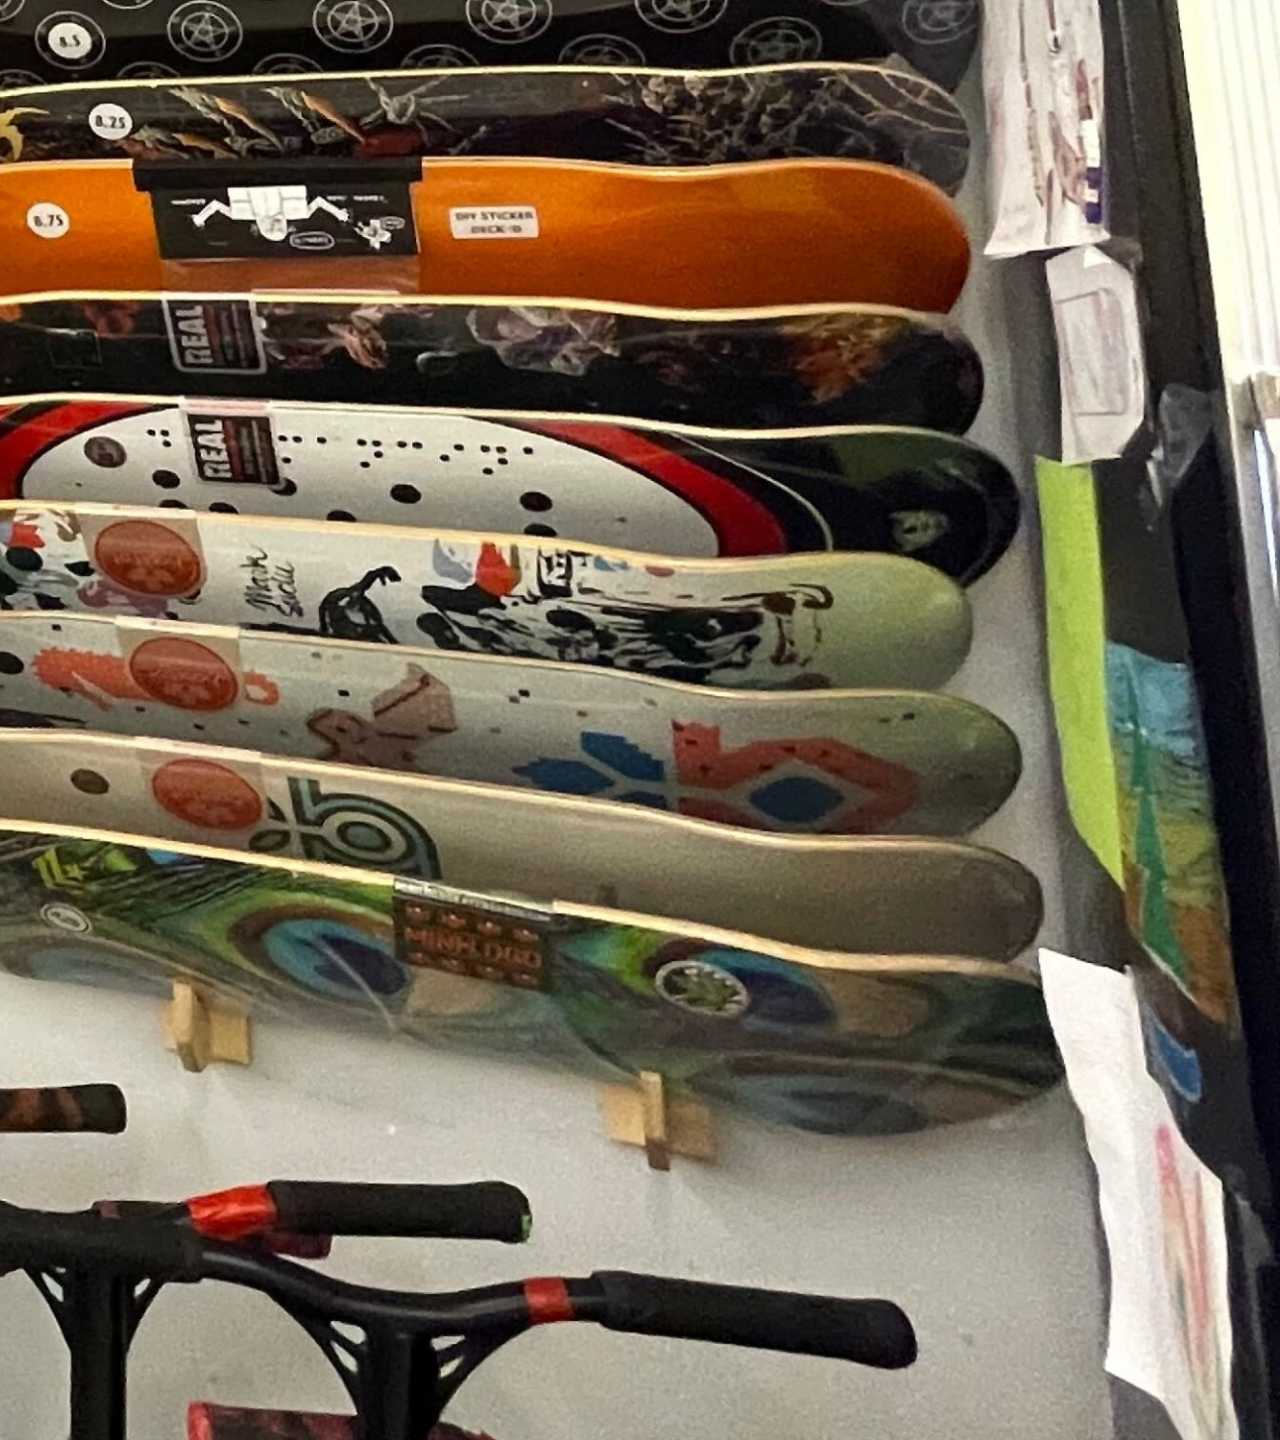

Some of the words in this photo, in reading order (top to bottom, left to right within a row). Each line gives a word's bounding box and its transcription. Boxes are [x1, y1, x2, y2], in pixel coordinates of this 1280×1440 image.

[95, 112, 126, 130] 8.25
[175, 304, 214, 364] REAL
[194, 419, 233, 478] REAL
